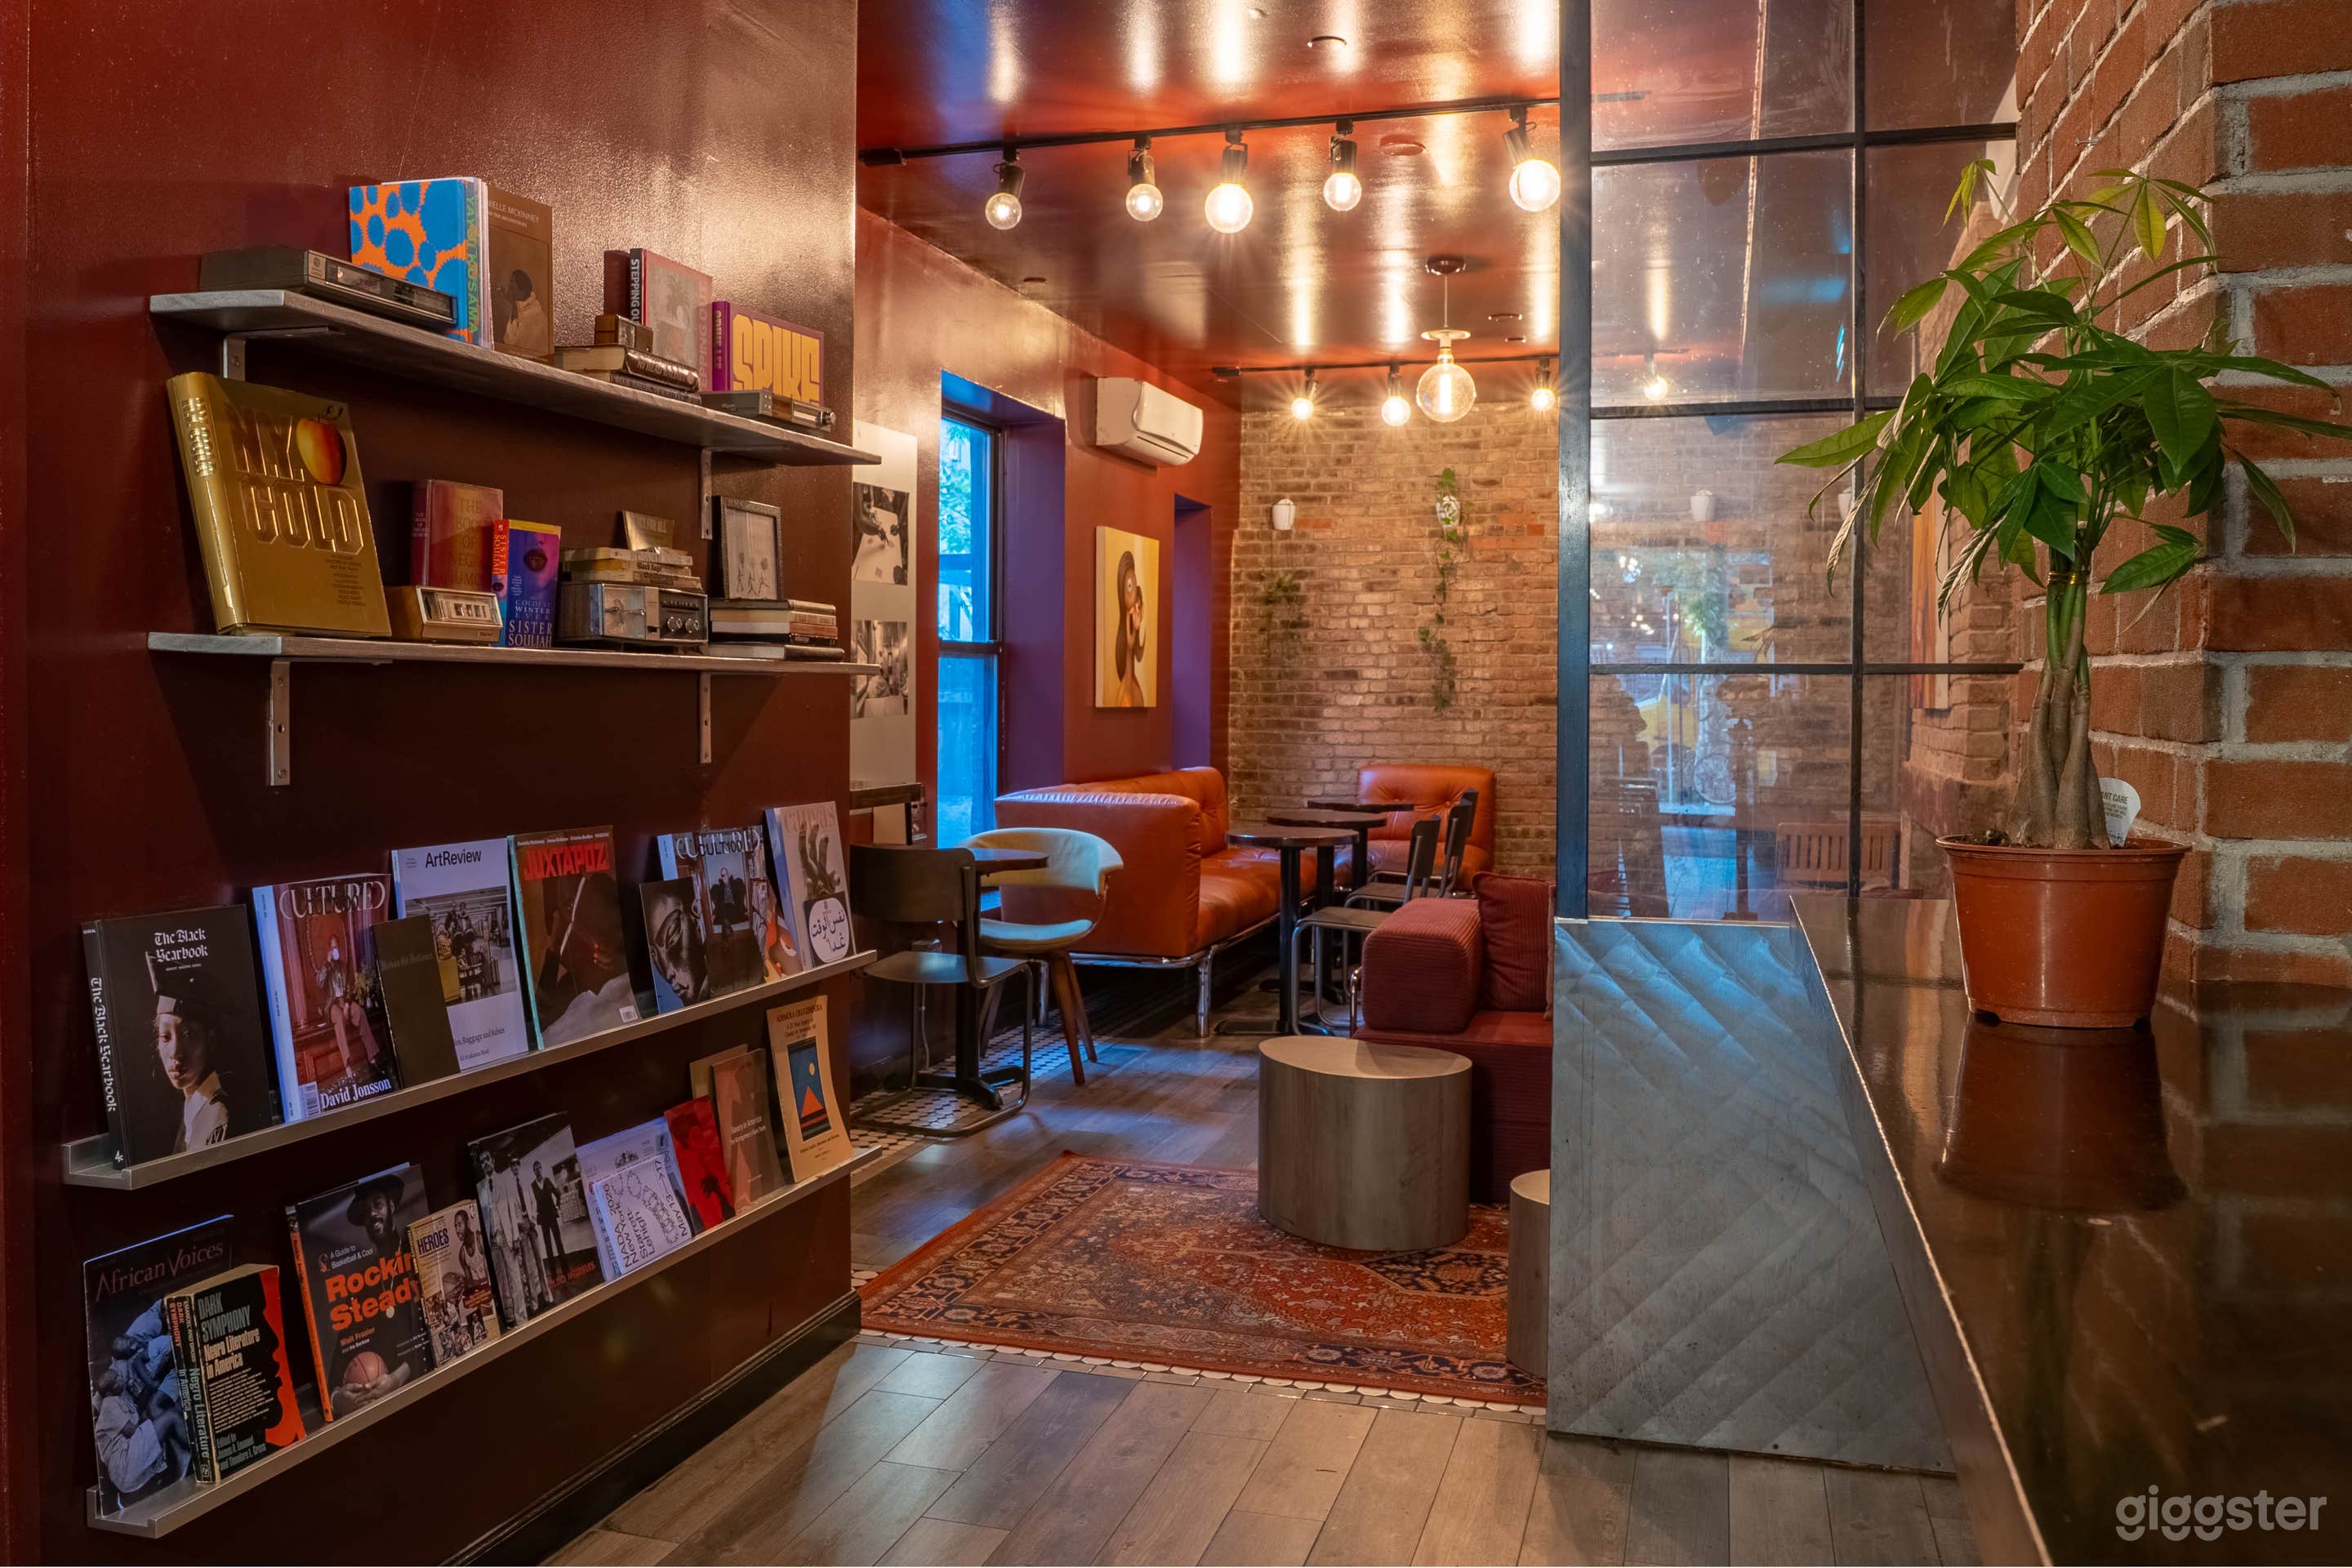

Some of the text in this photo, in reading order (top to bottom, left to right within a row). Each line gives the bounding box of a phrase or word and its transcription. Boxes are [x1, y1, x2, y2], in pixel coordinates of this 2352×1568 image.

[467, 253, 478, 333] KUSAMA
[630, 259, 640, 310] STEPPING
[698, 322, 708, 389] EPPING
[733, 314, 820, 406] SPIKE
[239, 475, 364, 555] GOLD
[509, 621, 553, 635] SISTER
[514, 606, 550, 615] WINTER
[2112, 794, 2129, 804] CARE
[425, 849, 482, 868] ArtReview
[523, 841, 610, 881] JUXTAPOZ
[154, 928, 207, 946] The Black
[156, 944, 208, 963] Yearbook
[91, 977, 117, 1112] The Black Yearbook
[320, 1086, 350, 1109] David
[352, 1078, 392, 1102] Jonsson
[654, 1160, 688, 1236] May 13 17
[335, 1246, 350, 1257] Guide
[416, 1227, 450, 1255] HEROES
[614, 1225, 633, 1267] NADA
[615, 1201, 639, 1264] New York
[635, 1211, 656, 1255] Lehigh
[96, 1241, 224, 1302] African Voices
[331, 1255, 357, 1269] Basketball
[198, 1292, 224, 1321] DARK
[202, 1305, 251, 1343] SYMPHONY
[330, 1277, 421, 1332] Steady
[170, 1302, 181, 1348] SYMPHONY
[204, 1327, 261, 1363] Negro Literature
[206, 1352, 243, 1379] in America
[180, 1378, 192, 1411] America
[189, 1367, 210, 1459] Negro Literature
